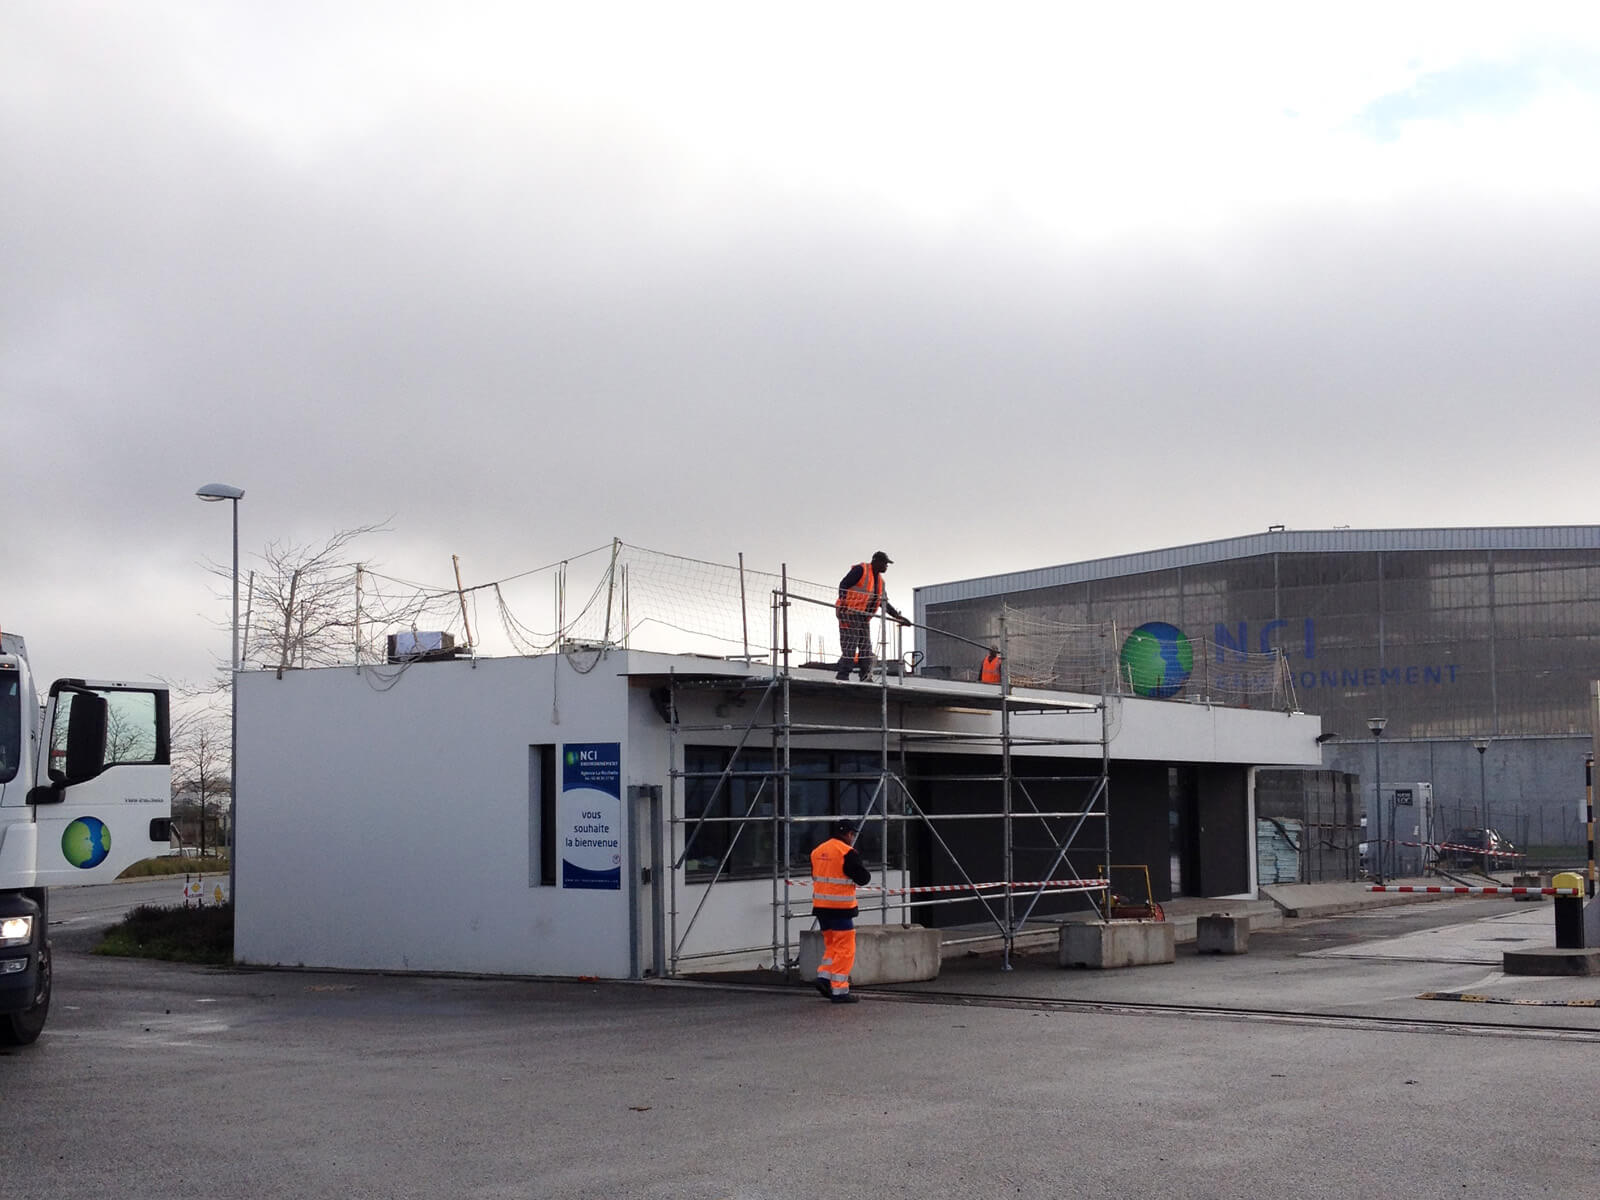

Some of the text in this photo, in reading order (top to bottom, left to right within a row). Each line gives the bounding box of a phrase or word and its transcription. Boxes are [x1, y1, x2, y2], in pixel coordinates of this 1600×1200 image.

[1215, 617, 1315, 664] NCI
[580, 750, 598, 761] NCI
[582, 811, 601, 819] vous
[574, 823, 609, 833] souhaite
[566, 837, 618, 848] la bienvenue
